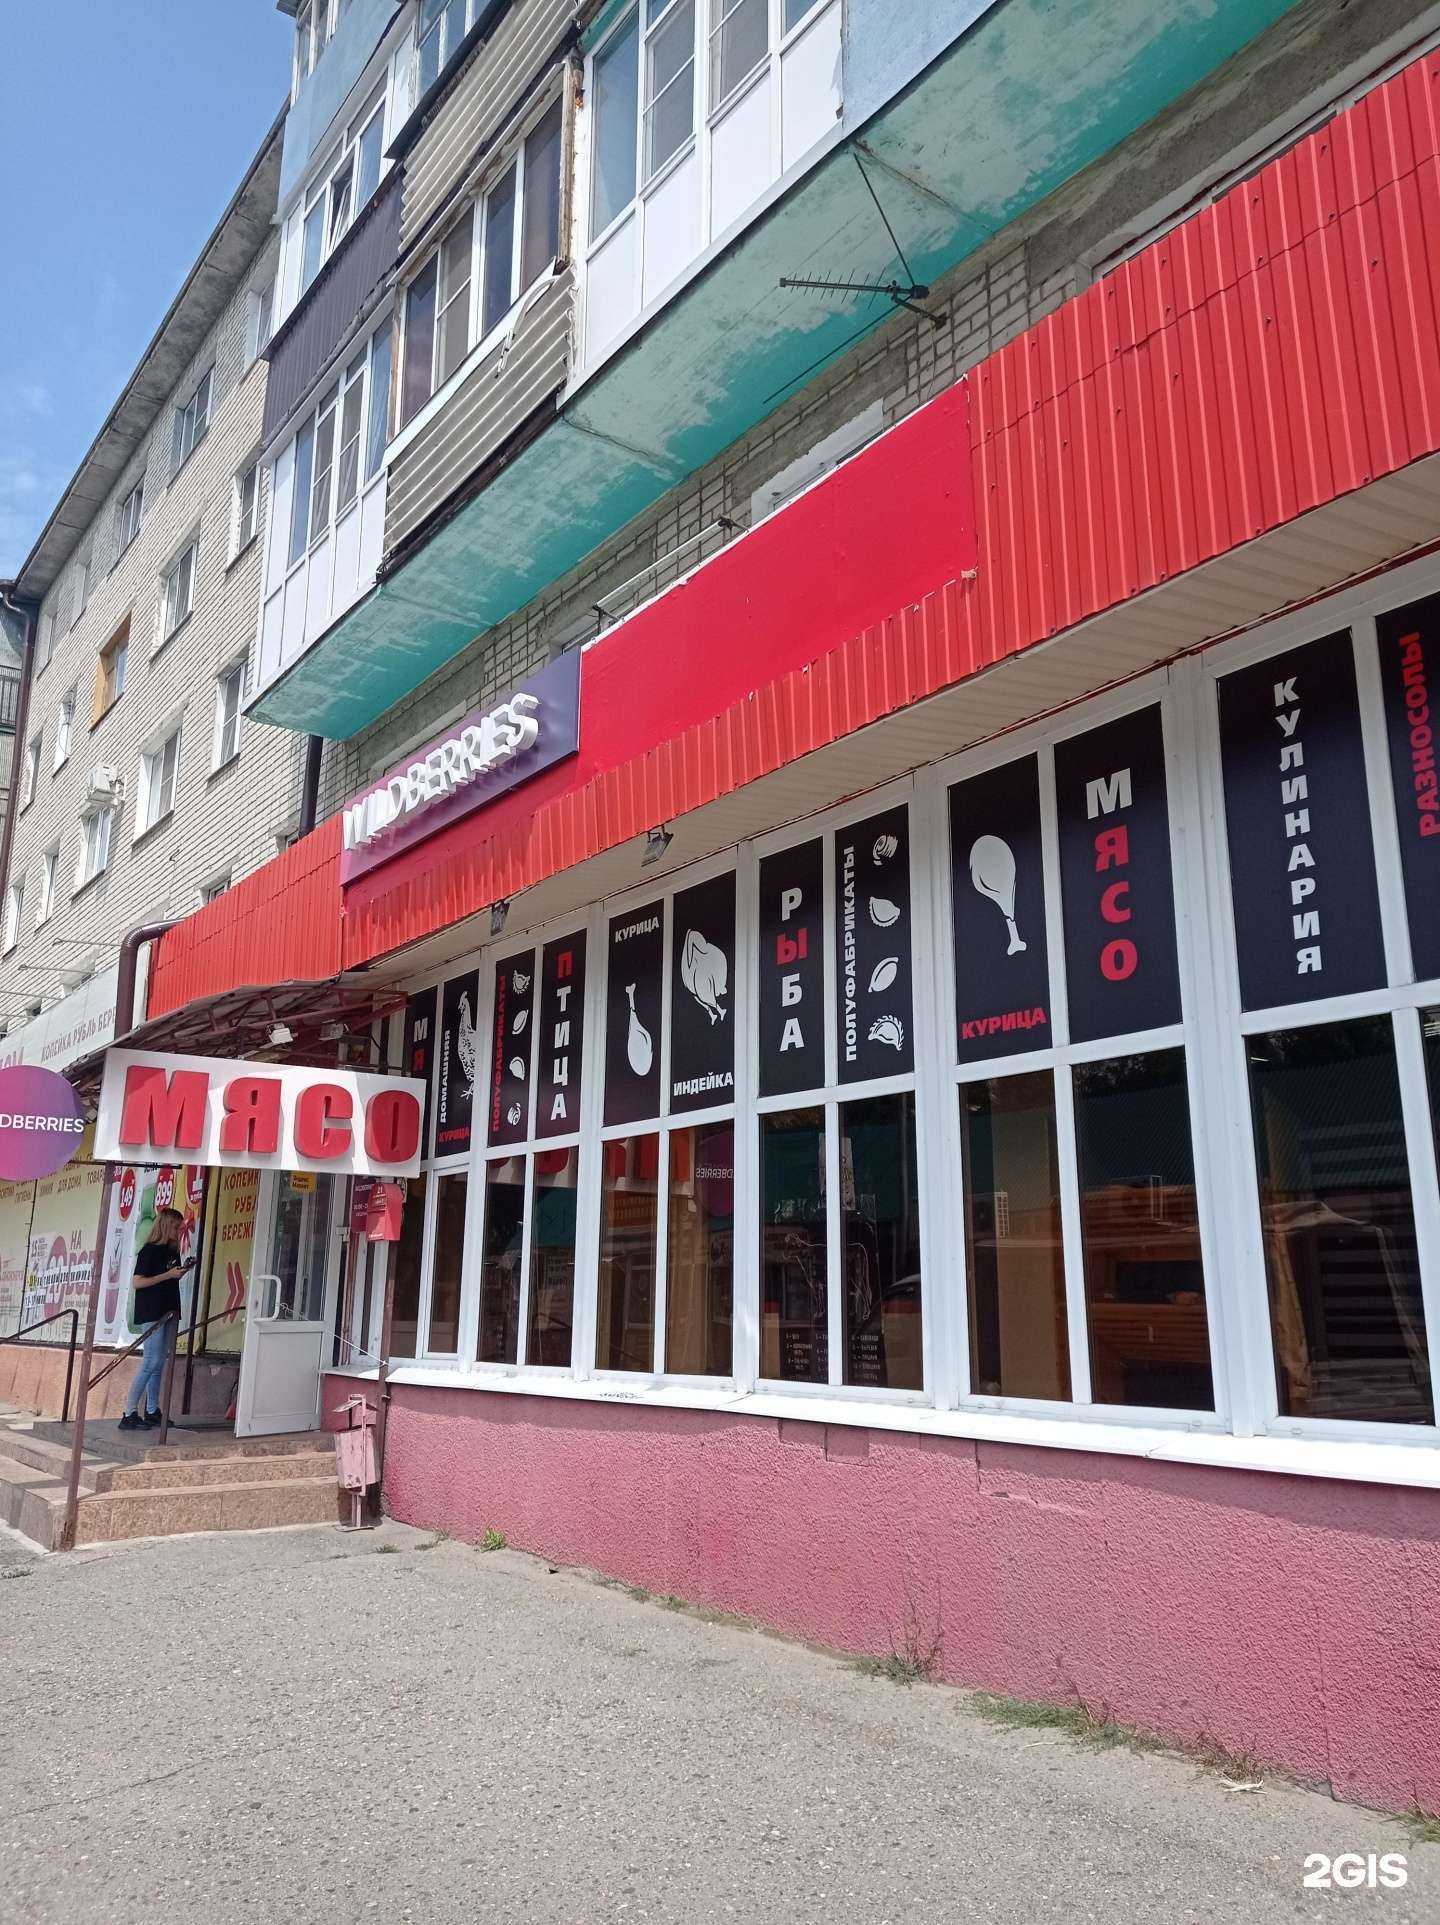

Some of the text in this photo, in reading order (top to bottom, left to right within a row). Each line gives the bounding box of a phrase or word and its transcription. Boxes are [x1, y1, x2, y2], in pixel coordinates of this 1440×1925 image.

[1399, 631, 1440, 838] РАЗНОСОЛЫ
[1085, 767, 1138, 982] МЯСО
[1273, 675, 1323, 975] КУЛИНАРИЯ
[614, 915, 660, 944] КУРИЦА
[776, 886, 809, 1053] РЫБА
[843, 845, 857, 1062] ПОЛУФАБРИКАТЫ
[550, 950, 573, 1122] ПТИЦА
[673, 1072, 734, 1097] ИНДЕЙКА
[962, 1007, 1047, 1040] КУРИЦА
[118, 1064, 420, 1164] МЯСО
[155, 1179, 173, 1207] 899
